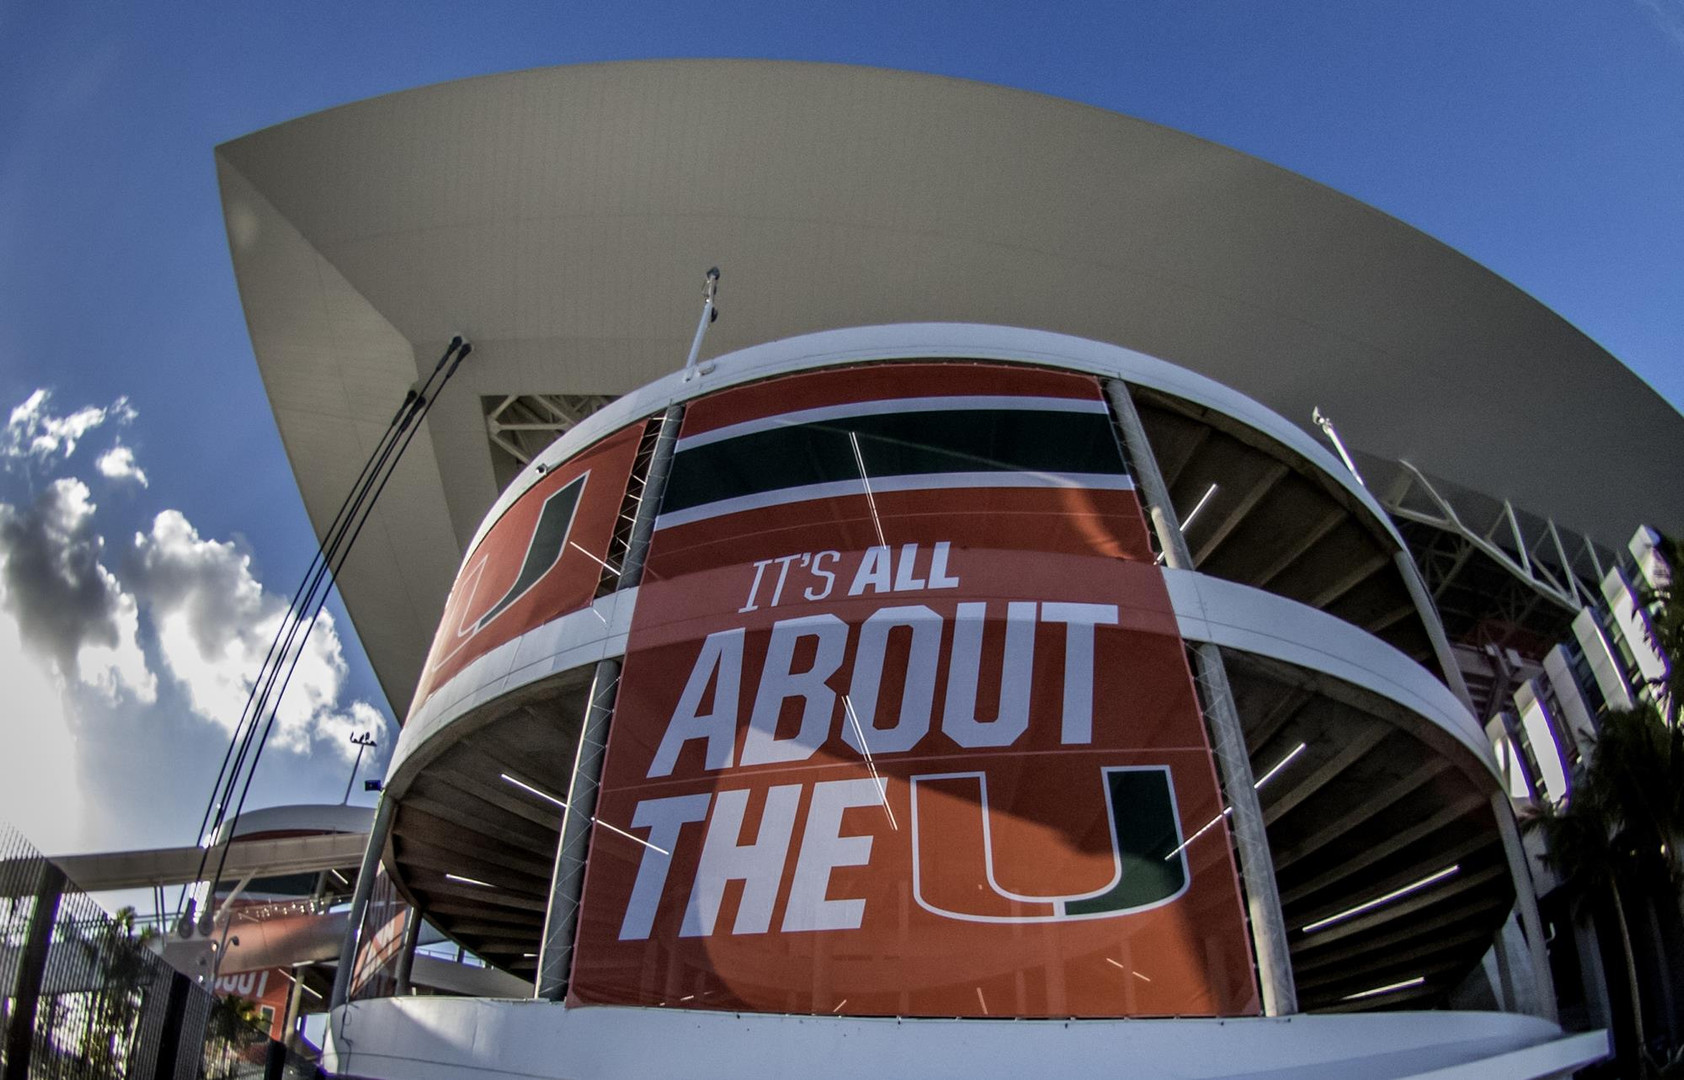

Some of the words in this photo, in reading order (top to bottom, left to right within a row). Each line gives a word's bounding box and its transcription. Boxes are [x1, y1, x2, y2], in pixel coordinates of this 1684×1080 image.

[738, 550, 841, 614] IT'S
[847, 541, 960, 596] ALL
[646, 601, 1119, 779] ABOUT
[618, 776, 888, 942] THE
[910, 765, 1191, 924] U
